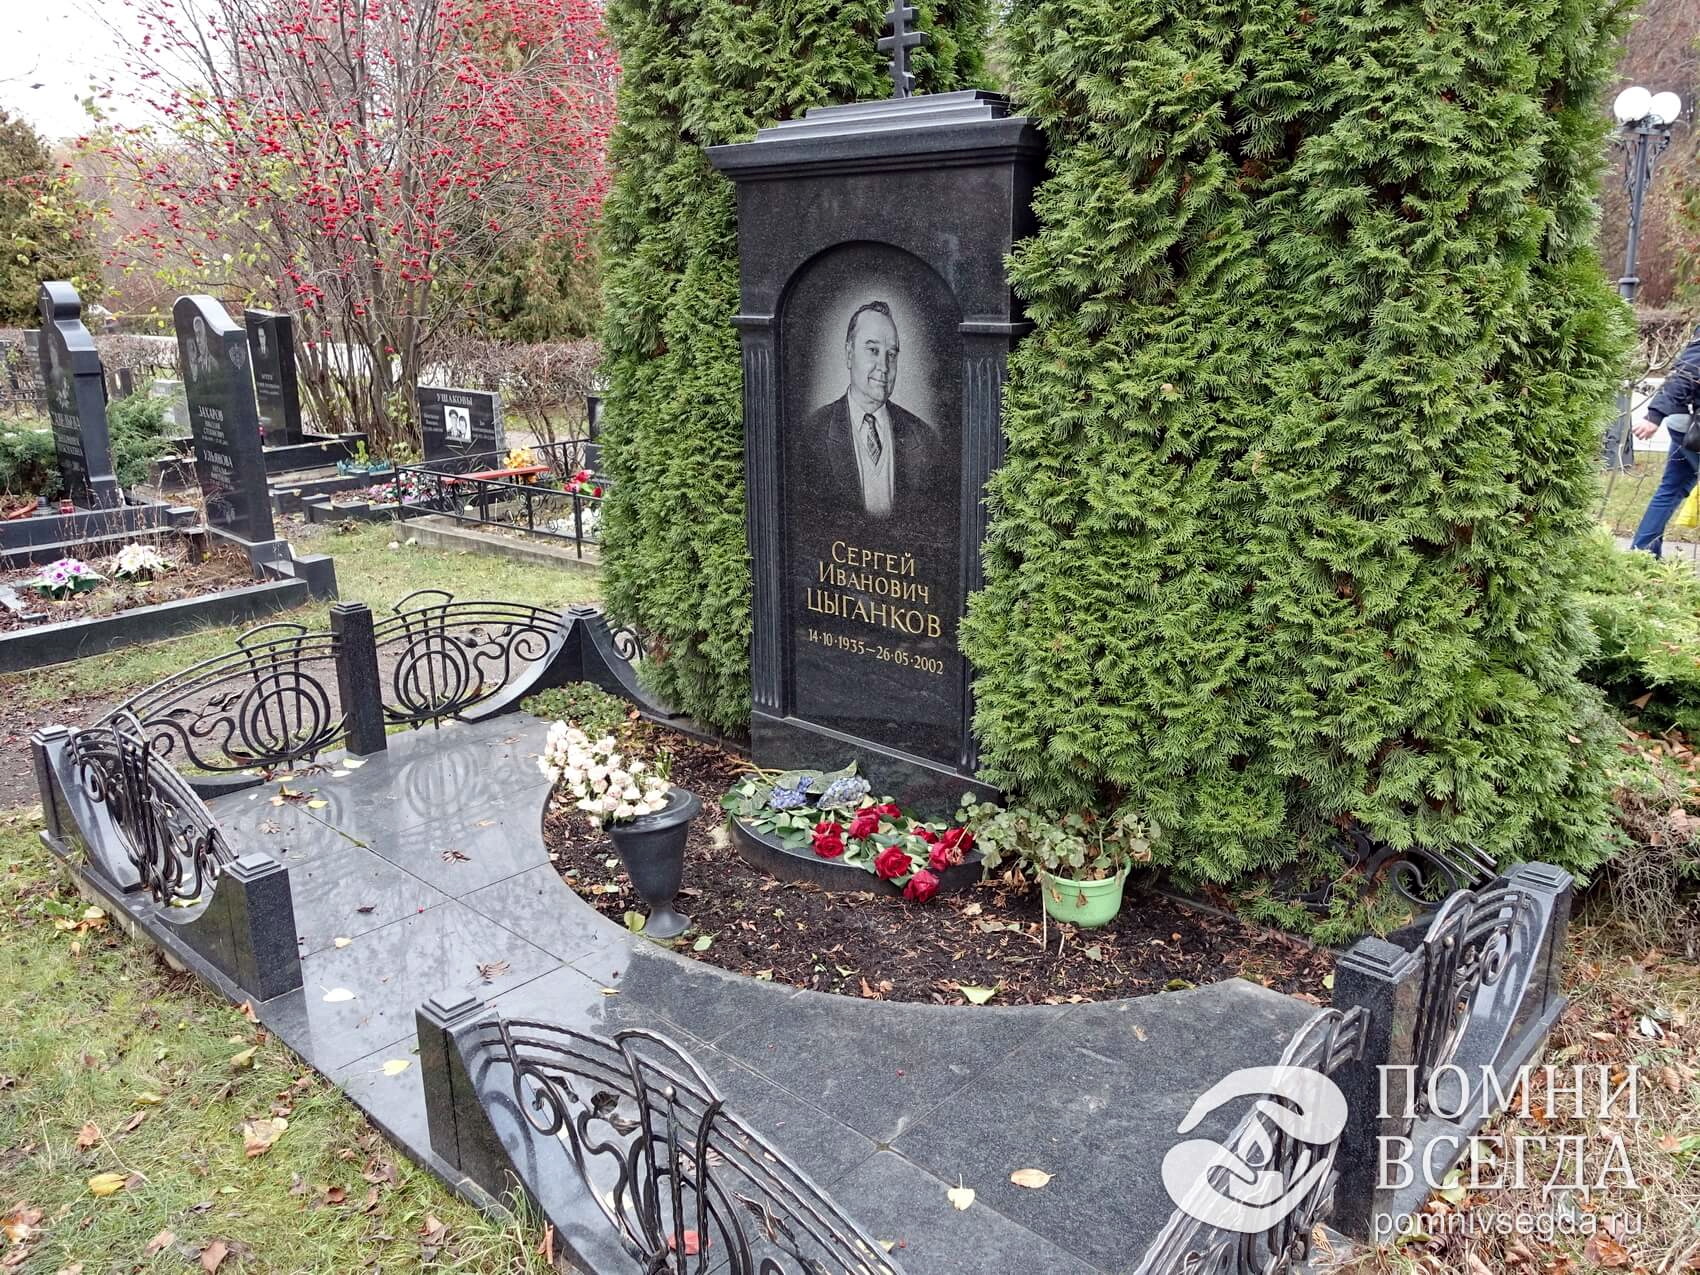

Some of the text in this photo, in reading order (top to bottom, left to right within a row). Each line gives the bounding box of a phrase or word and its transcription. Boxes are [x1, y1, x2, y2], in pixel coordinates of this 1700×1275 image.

[436, 393, 473, 406] УШАКОВЫ
[831, 540, 916, 577] СЕРГЕЙ
[819, 560, 930, 605] ИВАНОВИЧ
[807, 587, 942, 638] ЦЫГАНКОВ
